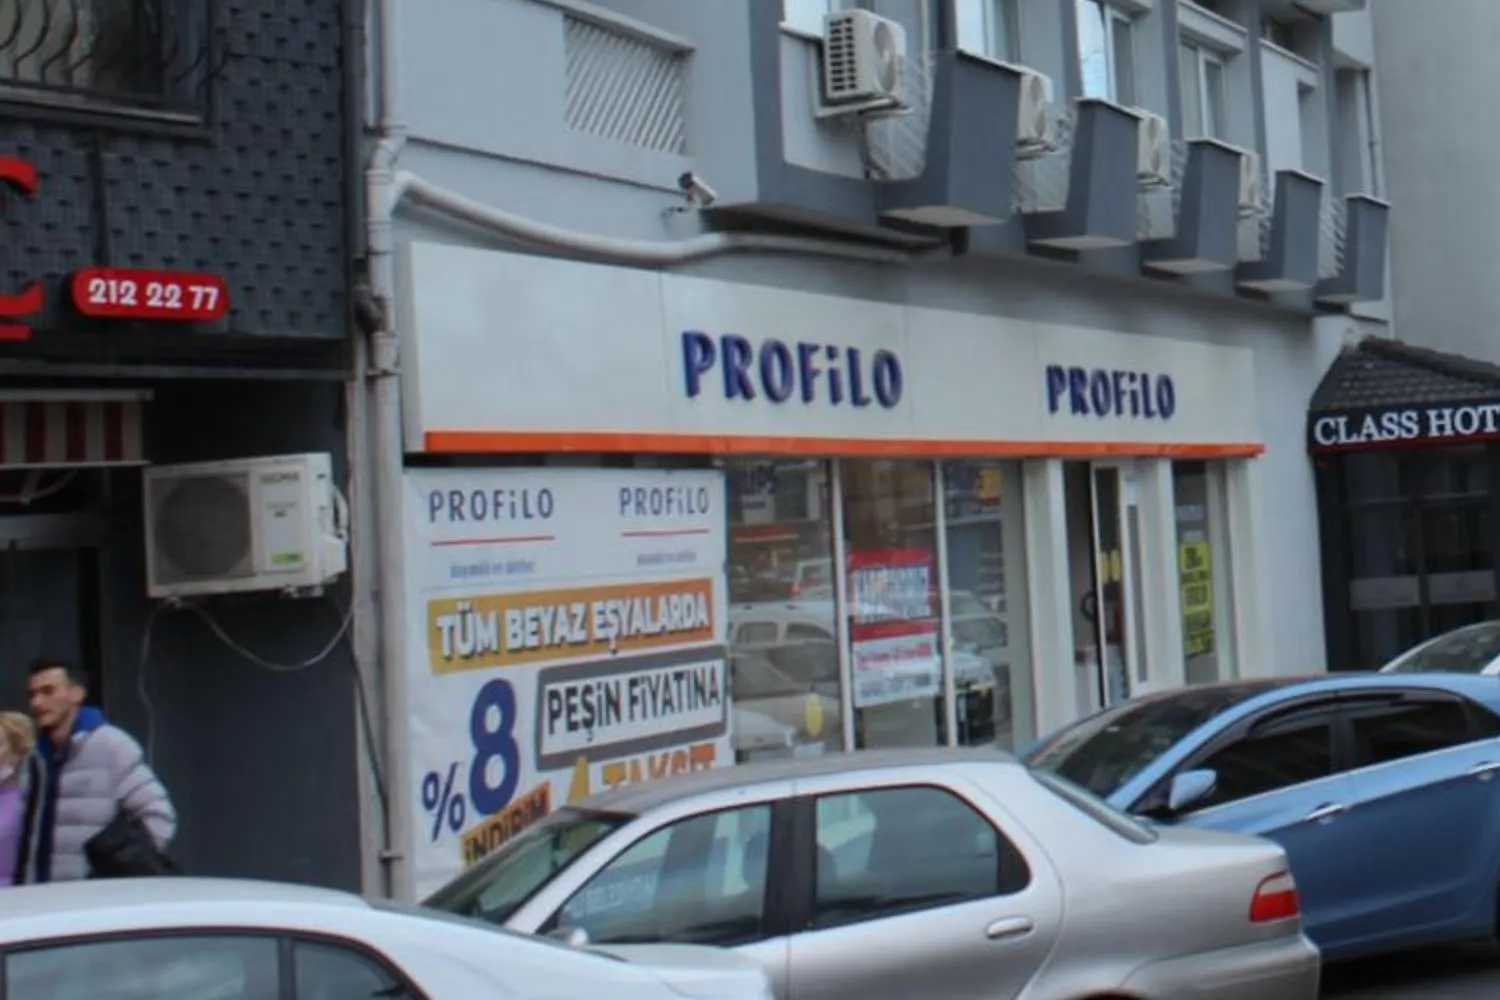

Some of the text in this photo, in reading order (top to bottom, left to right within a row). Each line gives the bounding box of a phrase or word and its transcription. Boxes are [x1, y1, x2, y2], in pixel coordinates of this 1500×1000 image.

[88, 278, 219, 310] 212 22 77
[1314, 410, 1419, 445] CLASS
[436, 592, 710, 661] TÜM BEYAZ EŞYALARDA
